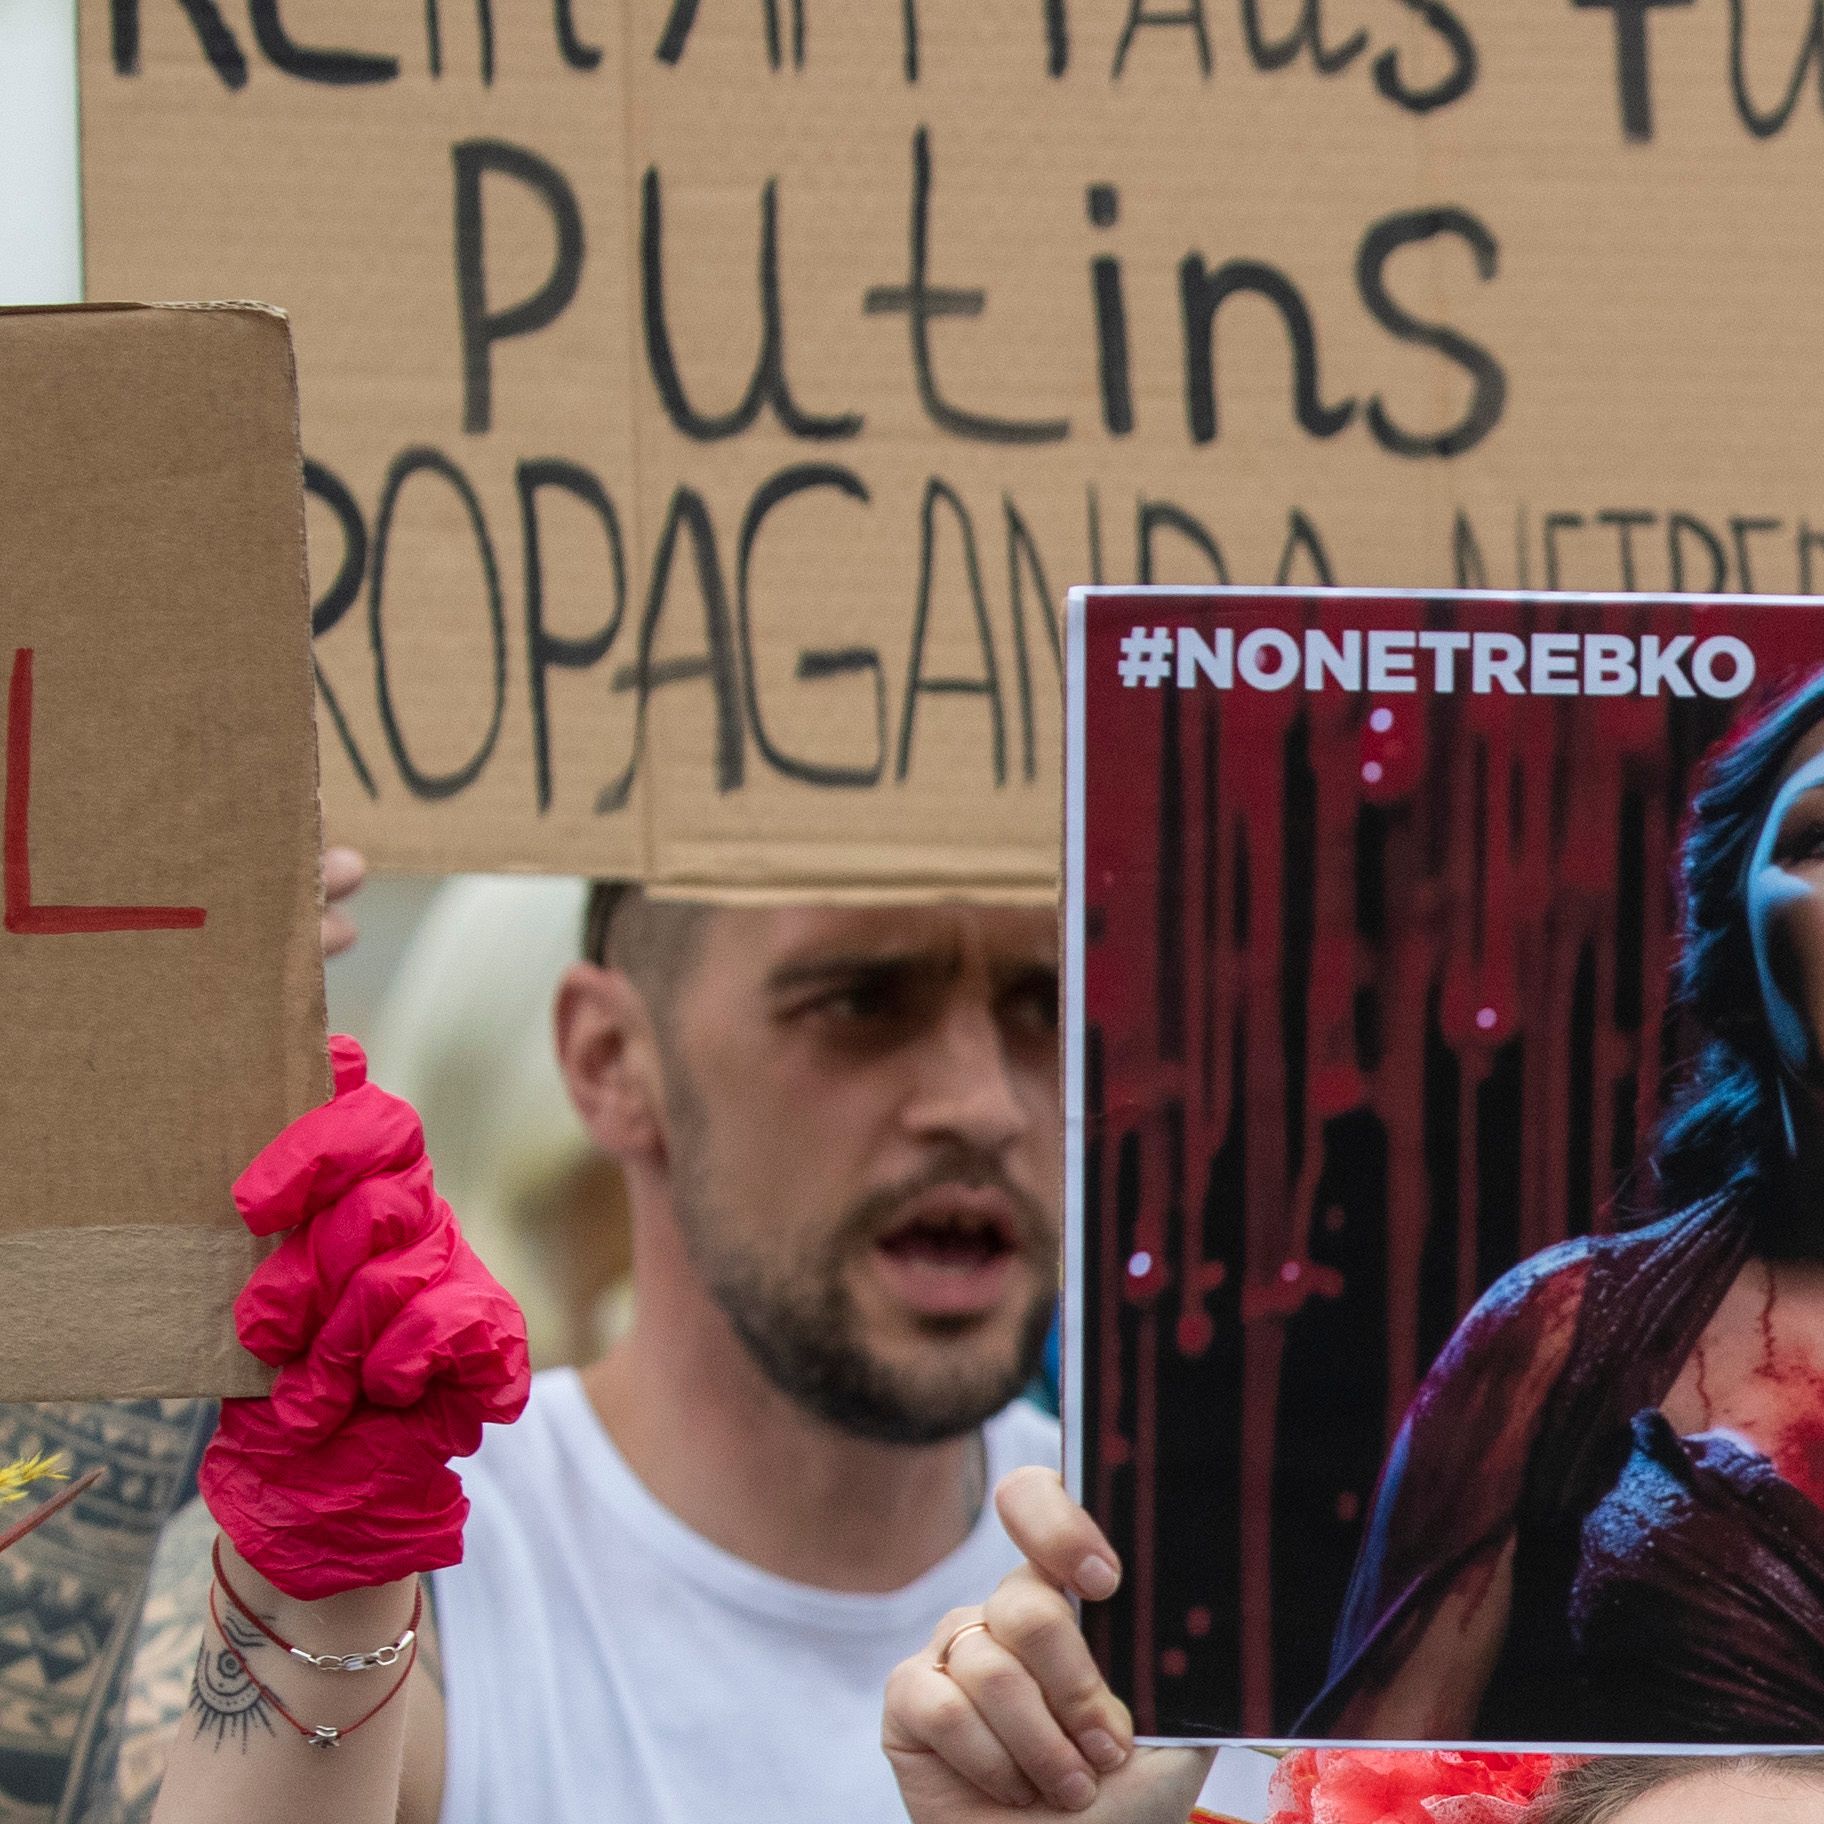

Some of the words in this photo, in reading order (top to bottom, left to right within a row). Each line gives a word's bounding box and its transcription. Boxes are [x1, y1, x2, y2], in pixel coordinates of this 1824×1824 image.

[450, 125, 1508, 460] Putins
[303, 443, 1338, 815] ROPAGAN
[1117, 624, 1757, 700] #NONETREBKO
